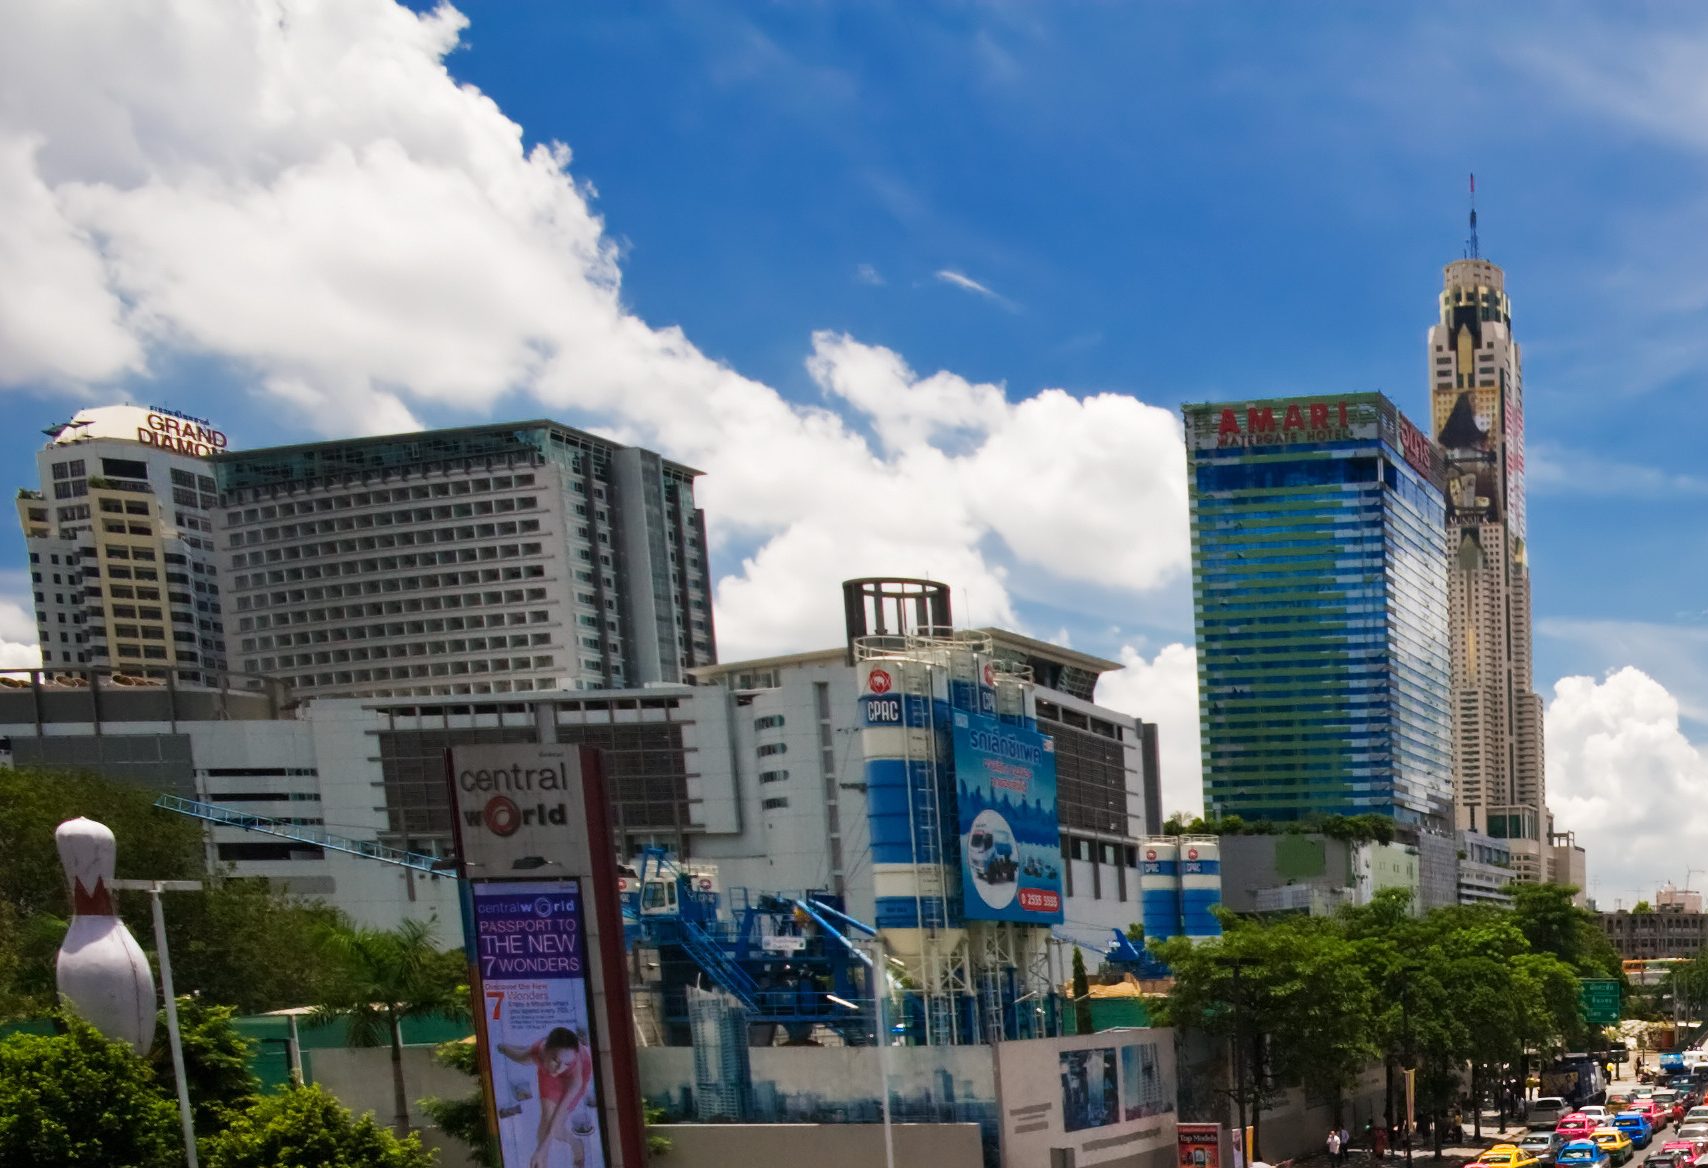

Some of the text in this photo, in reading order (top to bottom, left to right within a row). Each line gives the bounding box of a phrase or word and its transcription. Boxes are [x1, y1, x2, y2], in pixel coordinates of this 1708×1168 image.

[1218, 402, 1347, 434] AMARI
[147, 413, 228, 449] GRAND
[1307, 428, 1346, 440] HOTEL
[867, 700, 899, 721] CPAC
[460, 762, 568, 792] central
[480, 919, 576, 933] PASSPORT TO
[481, 934, 575, 954] THE NEW
[483, 956, 579, 976] 7 WONDERS
[487, 992, 504, 1020] 7
